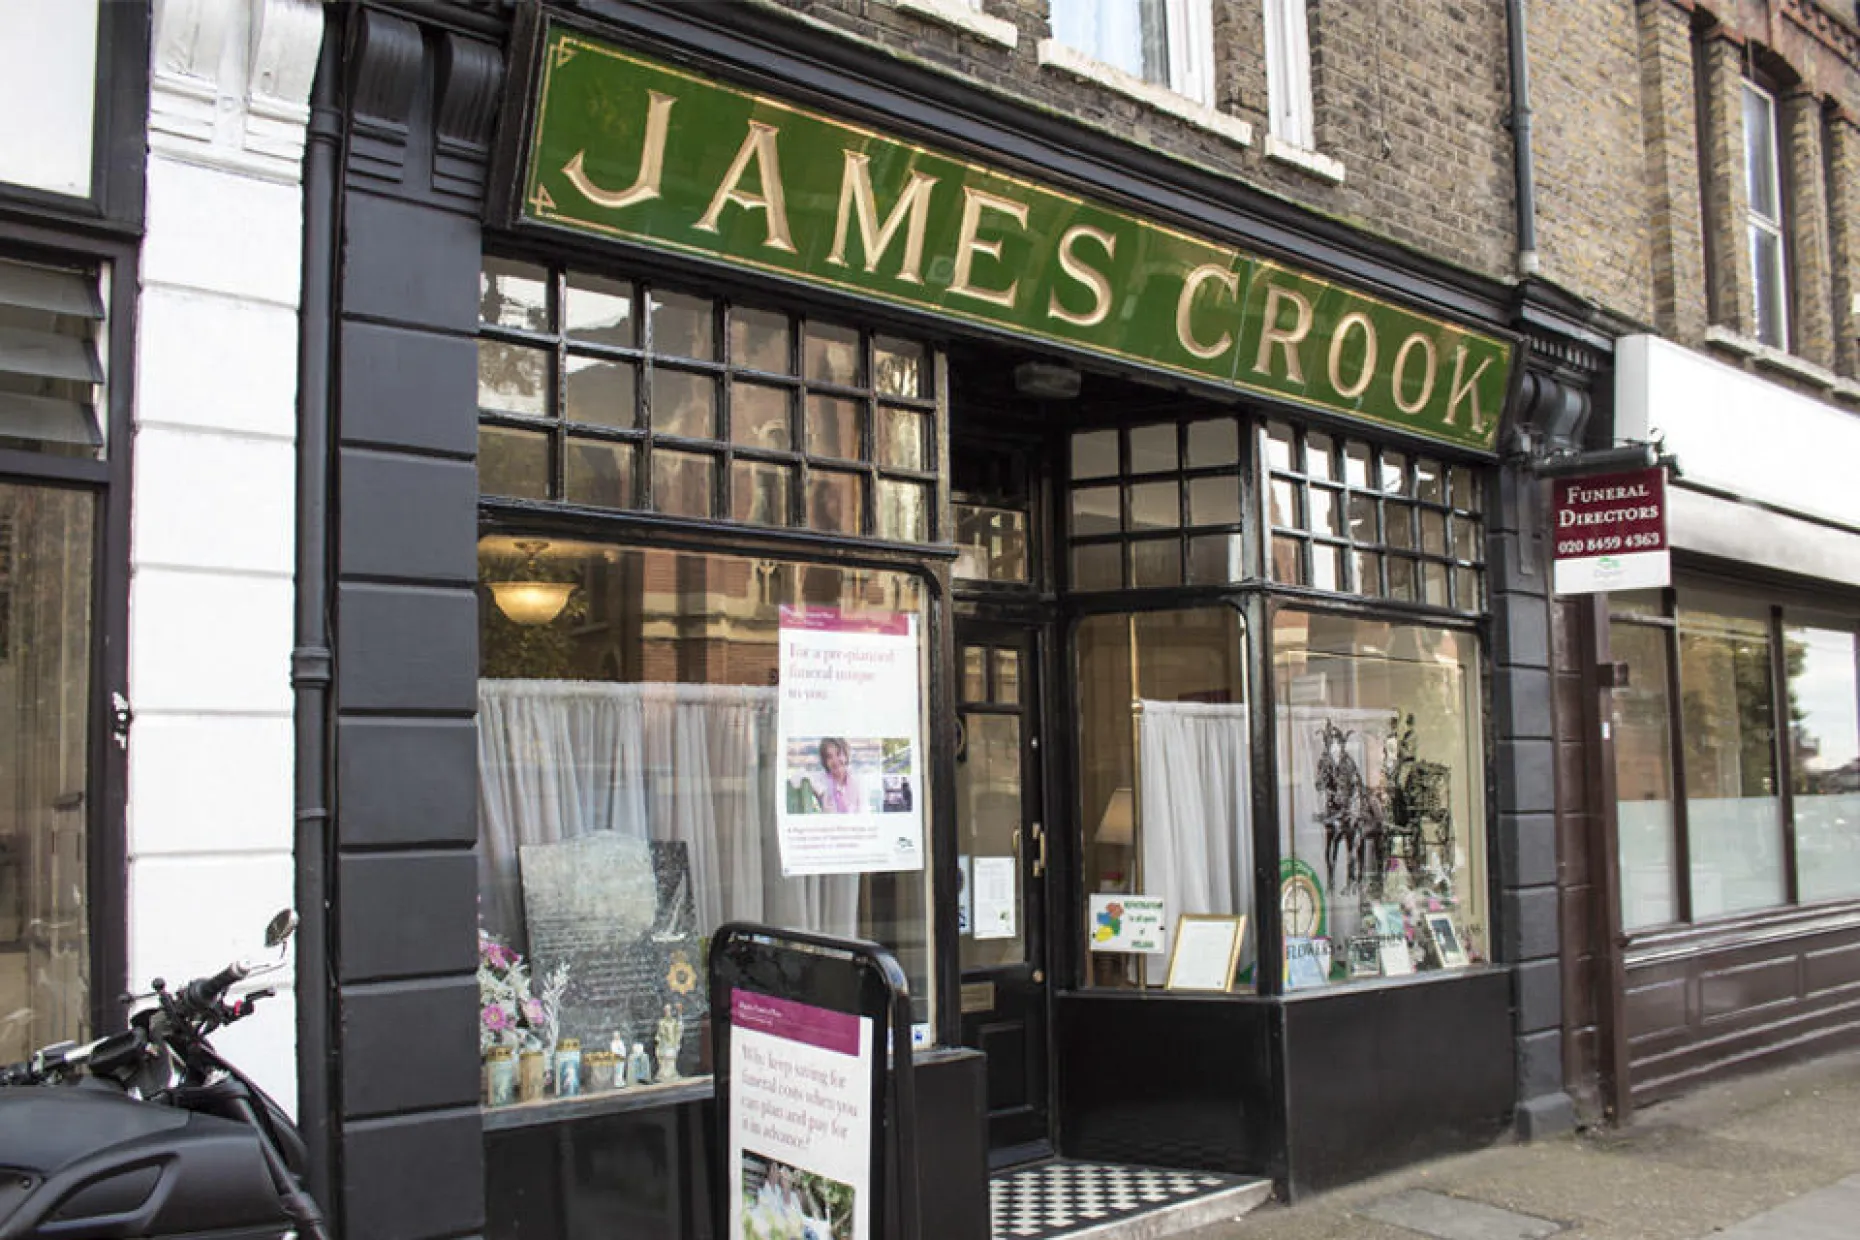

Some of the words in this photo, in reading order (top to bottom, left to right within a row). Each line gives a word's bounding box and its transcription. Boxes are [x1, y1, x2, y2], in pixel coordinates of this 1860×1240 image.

[561, 89, 1117, 327] JAMES
[1175, 262, 1495, 436] CROOK
[1566, 484, 1650, 504] FUNERAL
[1559, 505, 1659, 528] DIRECTORS
[1557, 539, 1584, 555] 020
[788, 662, 833, 679] funeral
[768, 1052, 792, 1078] keep
[830, 1070, 847, 1088] for
[741, 1069, 776, 1093] funeral
[837, 1099, 857, 1117] you
[761, 1099, 784, 1118] plan
[786, 1109, 807, 1126] and
[831, 1118, 848, 1139] for
